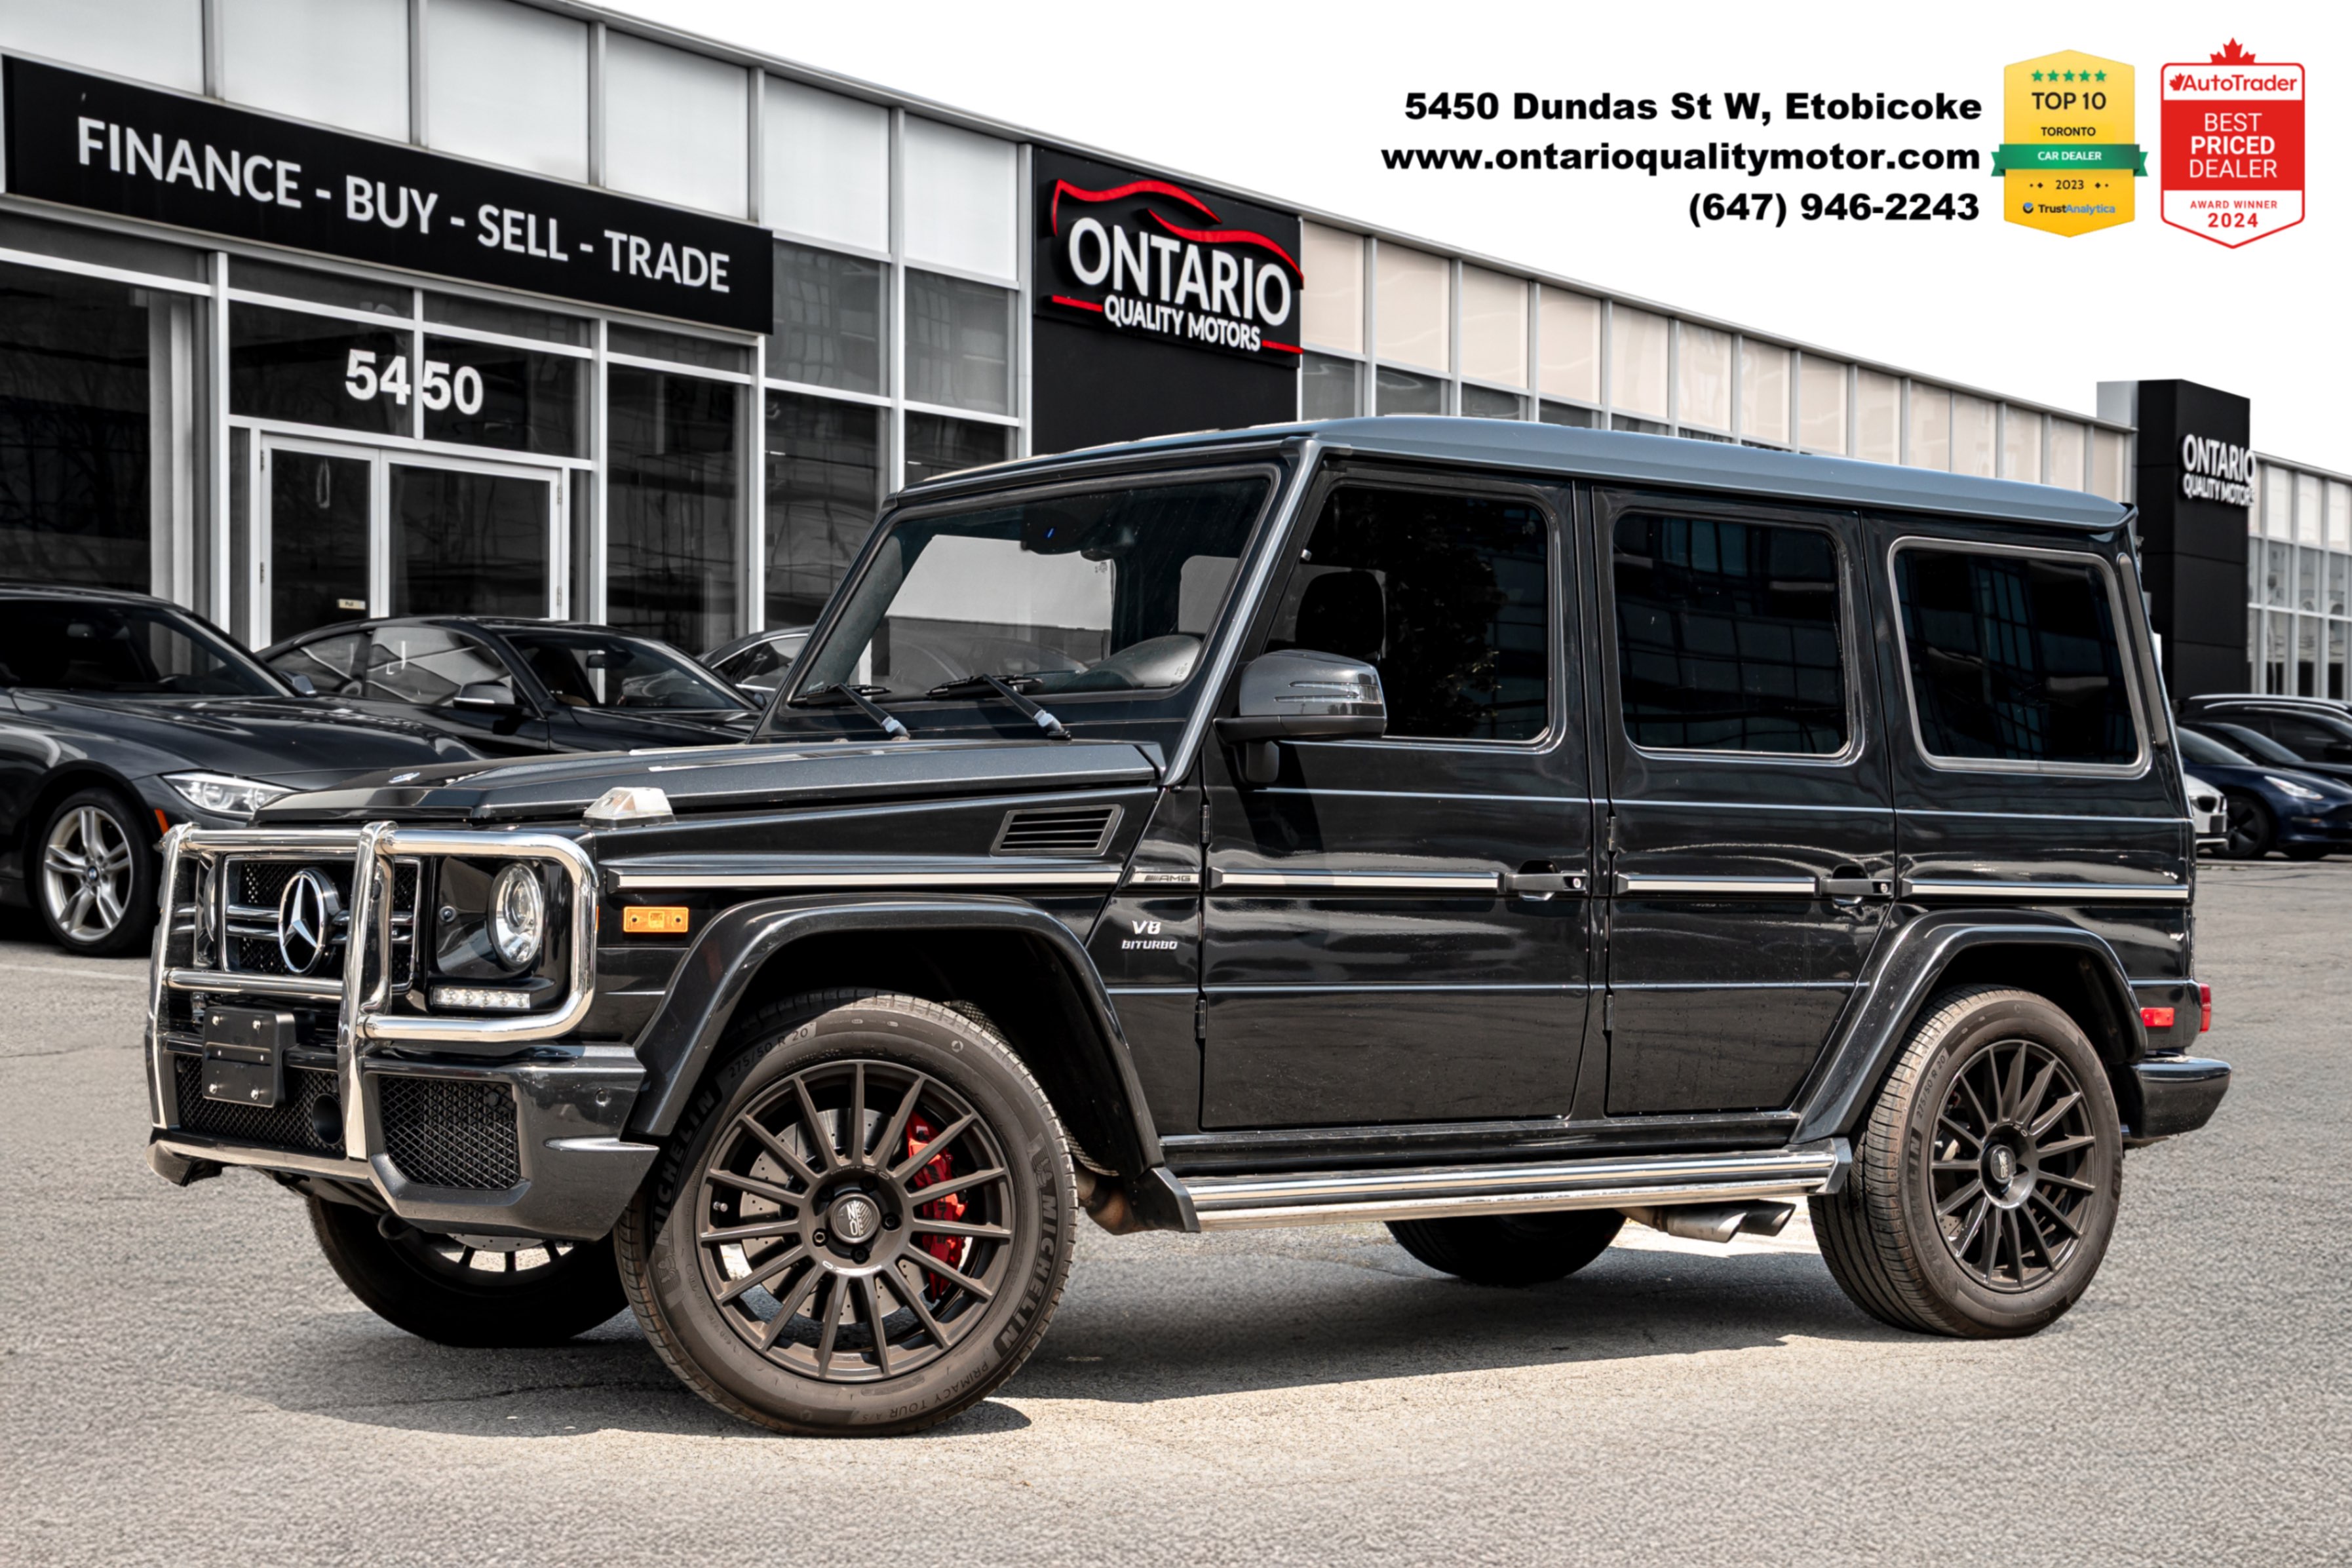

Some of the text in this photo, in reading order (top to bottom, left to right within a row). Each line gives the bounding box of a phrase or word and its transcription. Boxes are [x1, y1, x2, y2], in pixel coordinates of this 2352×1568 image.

[78, 116, 302, 209] FINANCE
[346, 174, 438, 235] BUY
[477, 204, 568, 261] SELL
[604, 229, 730, 294] TRADE
[1068, 217, 1291, 326] ONTARIO
[1104, 294, 1261, 352] QUALITY MOTORS
[345, 348, 484, 415] 5450
[2182, 433, 2257, 484] ONTARIO
[2182, 473, 2255, 507] QUALITY MOTORS
[1121, 940, 1178, 950] BITURBO
[1132, 920, 1161, 934] V8
[729, 1042, 773, 1078] 275/50
[777, 1035, 786, 1047] R
[792, 1027, 808, 1041] 20
[1916, 1054, 1946, 1120] 275/50 R 20
[1000, 1193, 1057, 1349] MICHELIN
[934, 1361, 990, 1404] PRIMACY
[862, 1413, 883, 1422] A/S
[889, 1400, 927, 1419] TOUR
